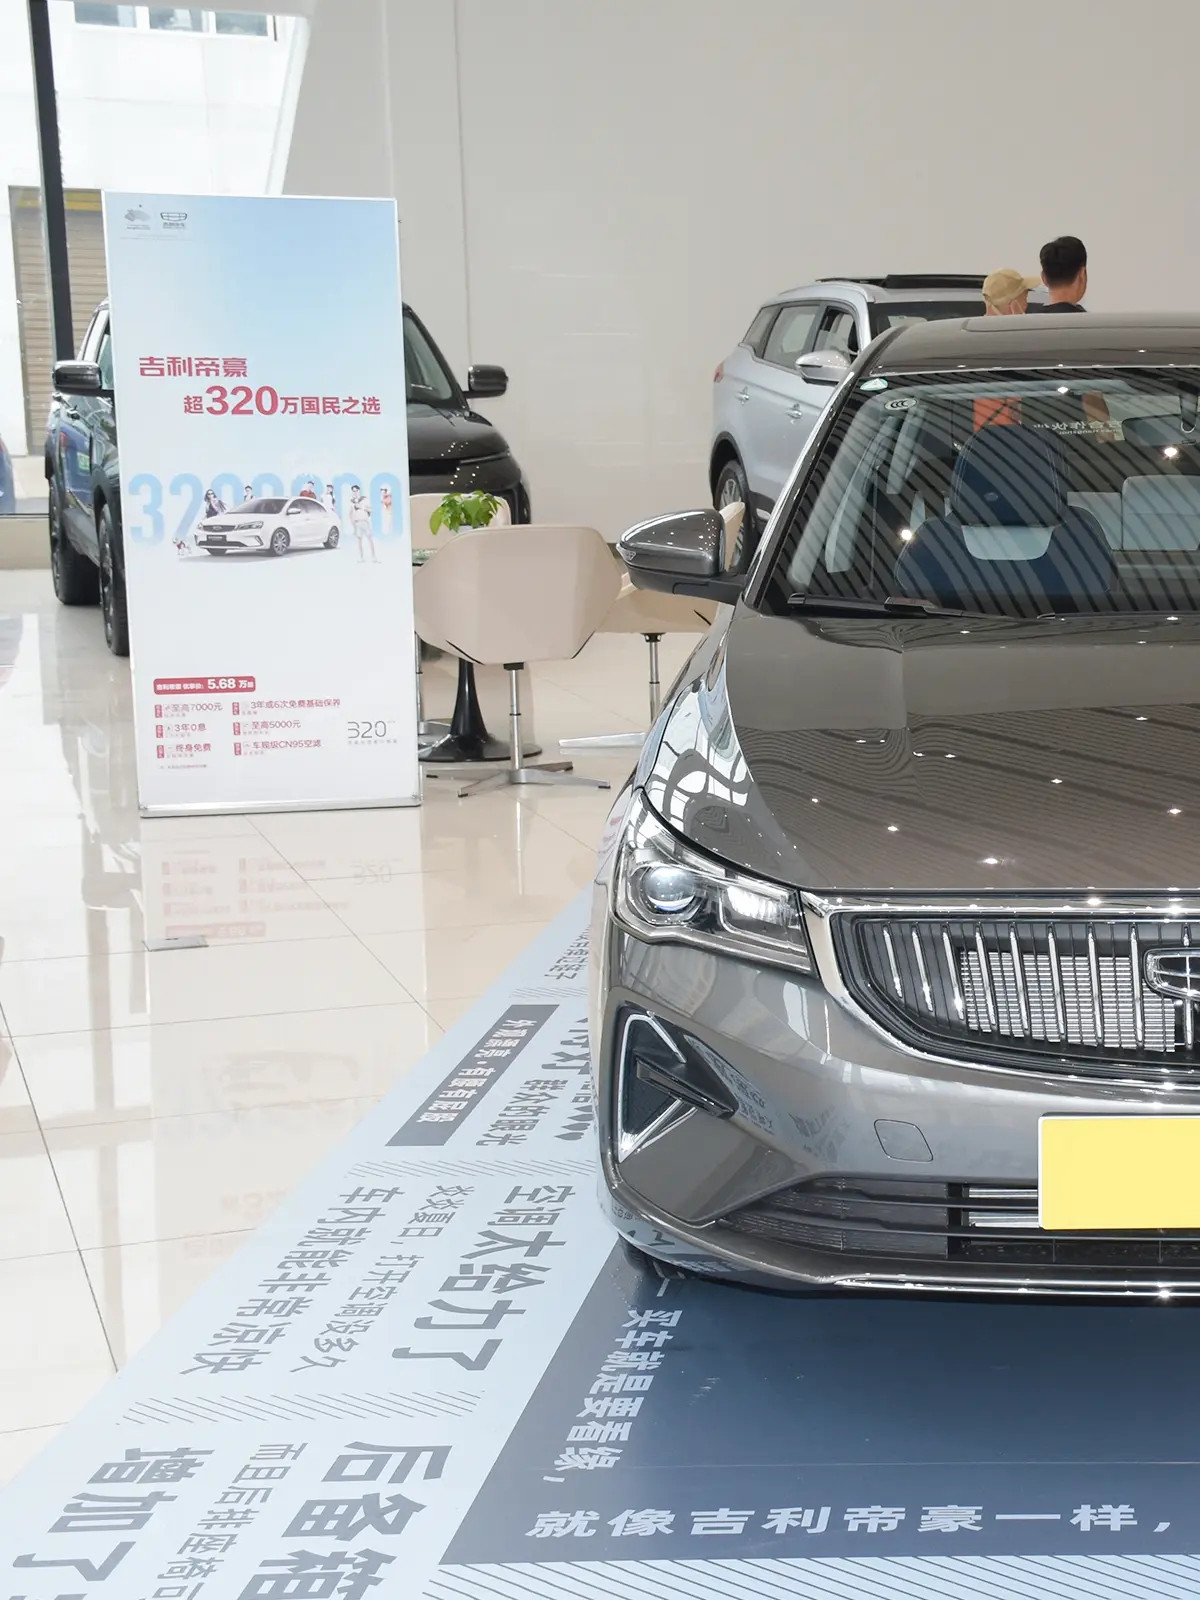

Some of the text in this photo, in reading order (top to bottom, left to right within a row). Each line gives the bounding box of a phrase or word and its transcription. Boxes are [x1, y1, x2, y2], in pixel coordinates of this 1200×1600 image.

[139, 356, 248, 378] 吉利帝豪
[184, 385, 381, 415] 超320万国民之选
[207, 678, 236, 690] 5.68
[347, 720, 387, 738] 320
[475, 1079, 569, 1146] 群众的眼光
[180, 1186, 405, 1375] 车内就能非常凉快
[391, 1185, 576, 1371] 空调太给力了
[10, 1447, 215, 1600] 增加了
[236, 1440, 453, 1600] 后备箱
